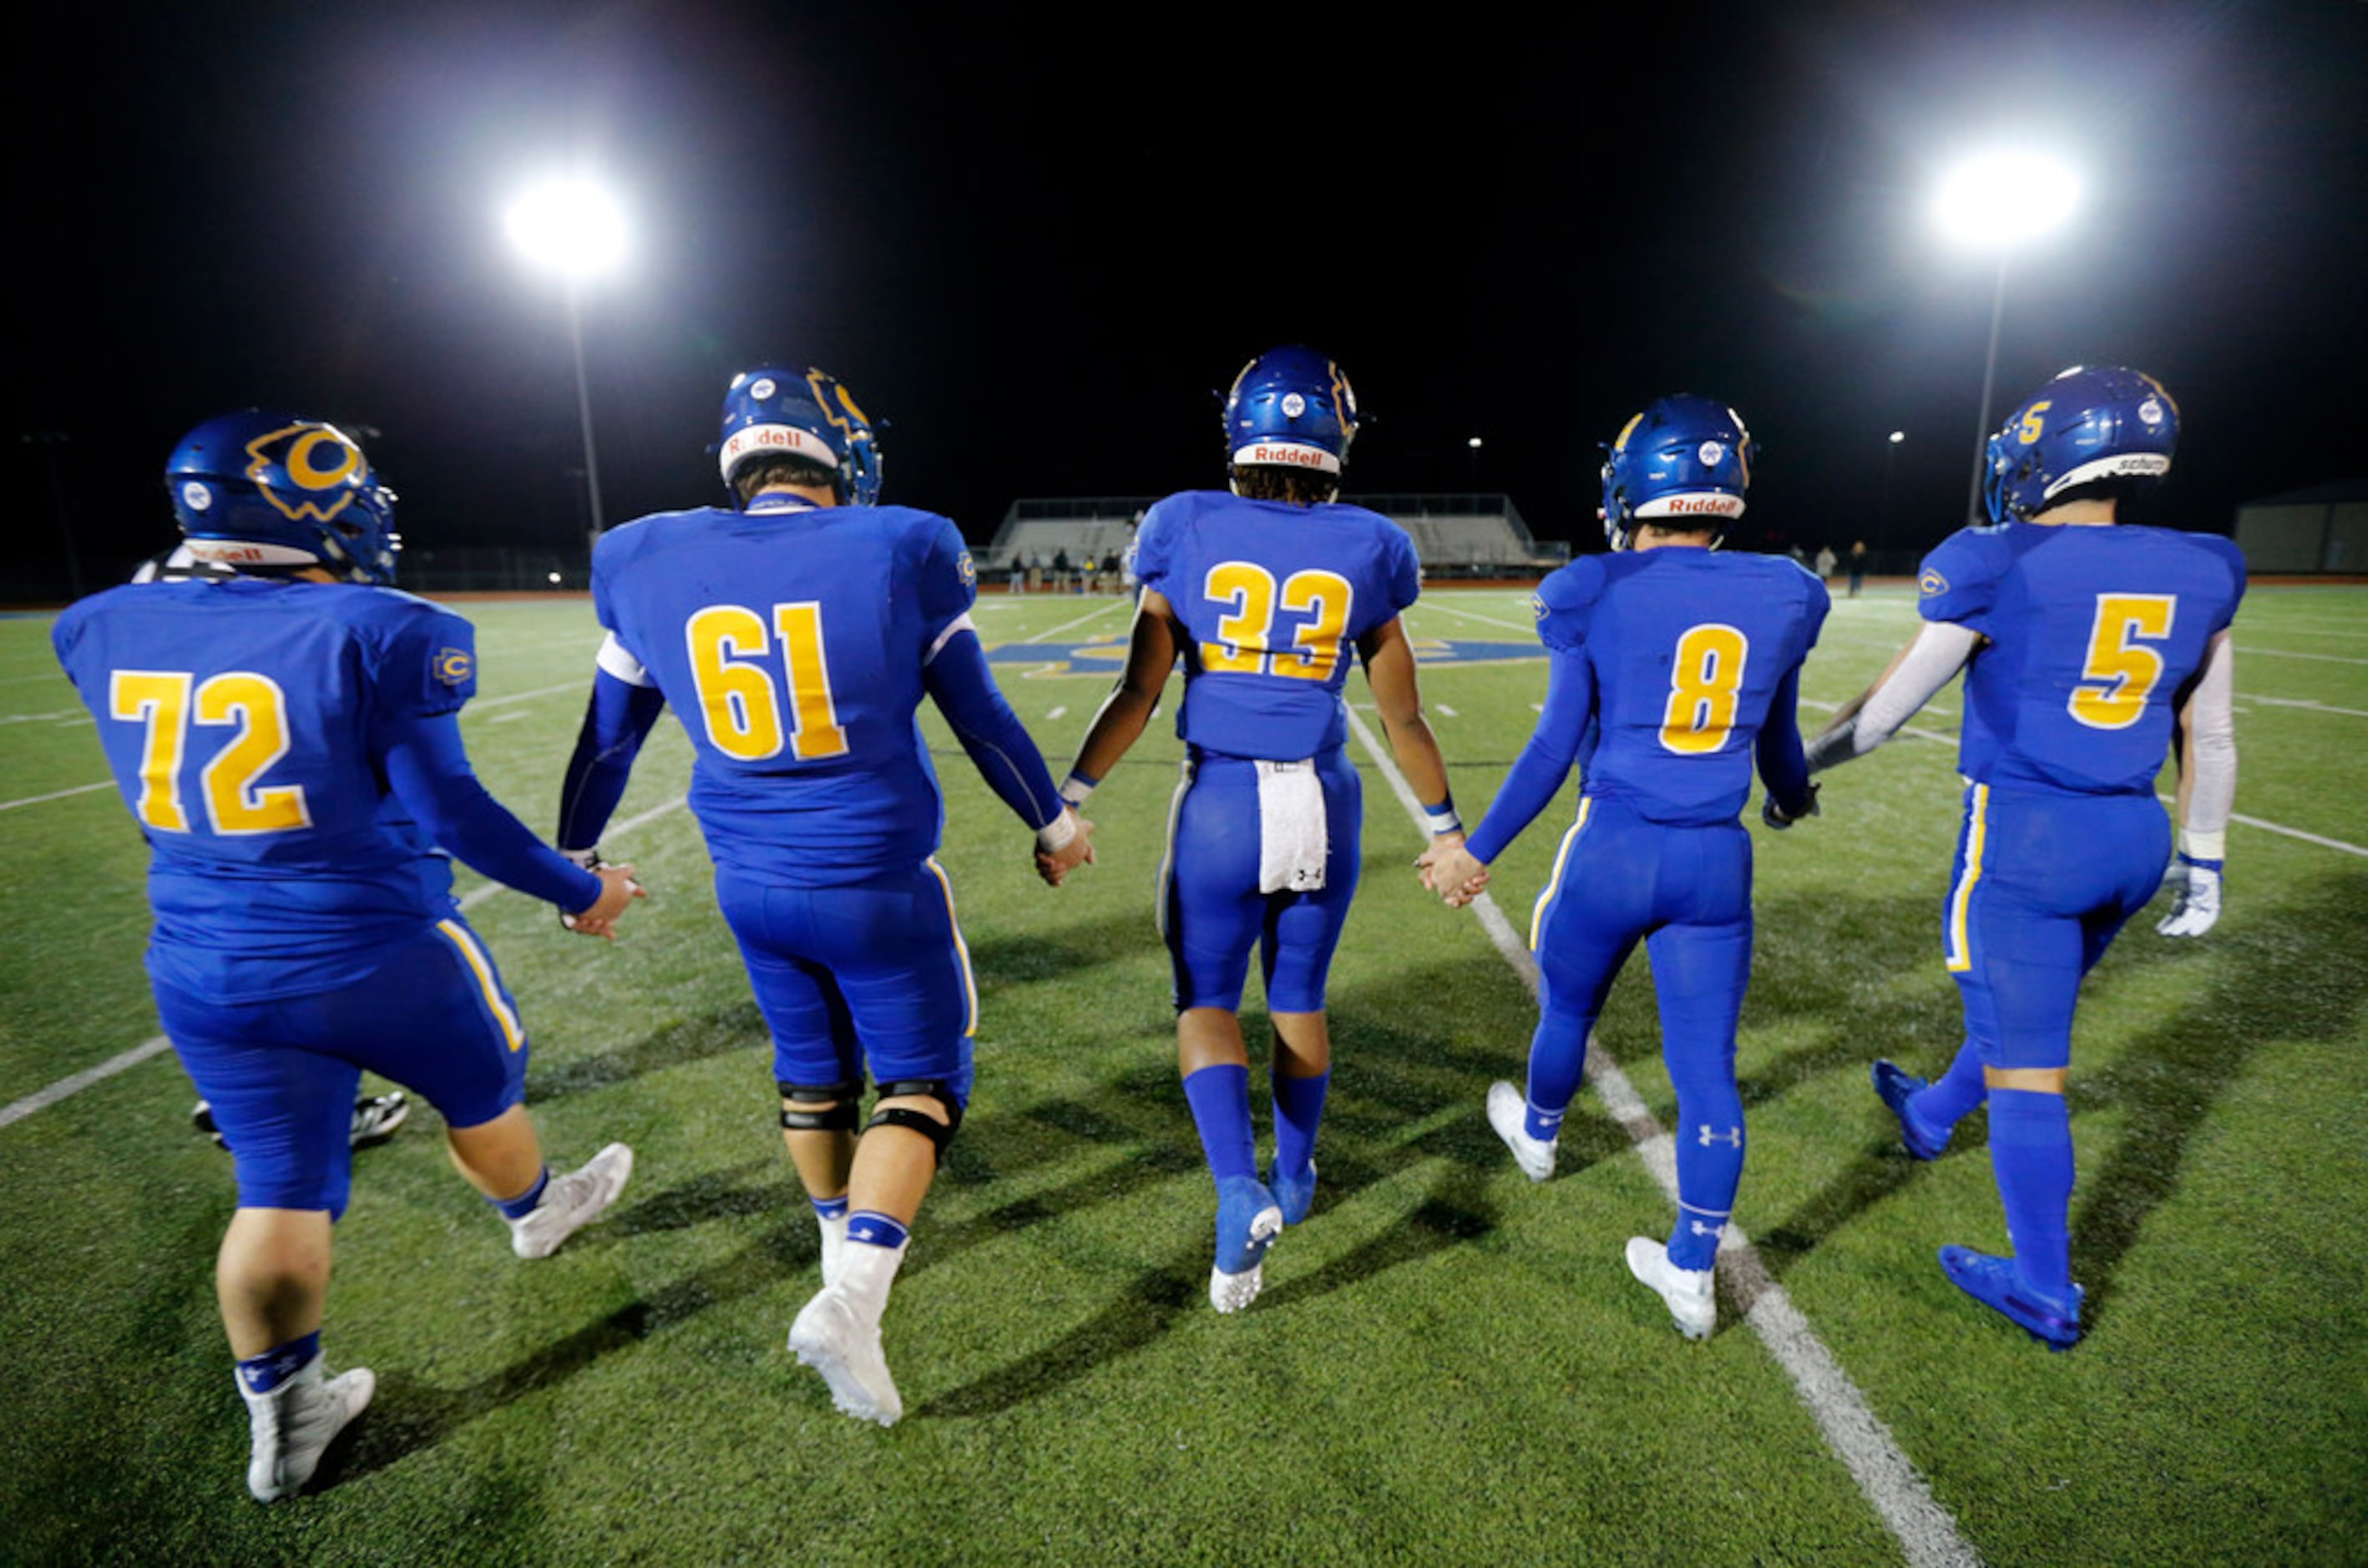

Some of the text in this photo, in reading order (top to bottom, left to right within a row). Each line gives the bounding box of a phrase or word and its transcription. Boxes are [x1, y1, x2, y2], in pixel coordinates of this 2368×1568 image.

[1255, 446, 1323, 466] Riddell
[686, 600, 849, 762] 61
[1199, 560, 1354, 681] 33
[2067, 593, 2178, 731] 5
[109, 669, 313, 836] 72
[1658, 623, 1749, 756] 8
